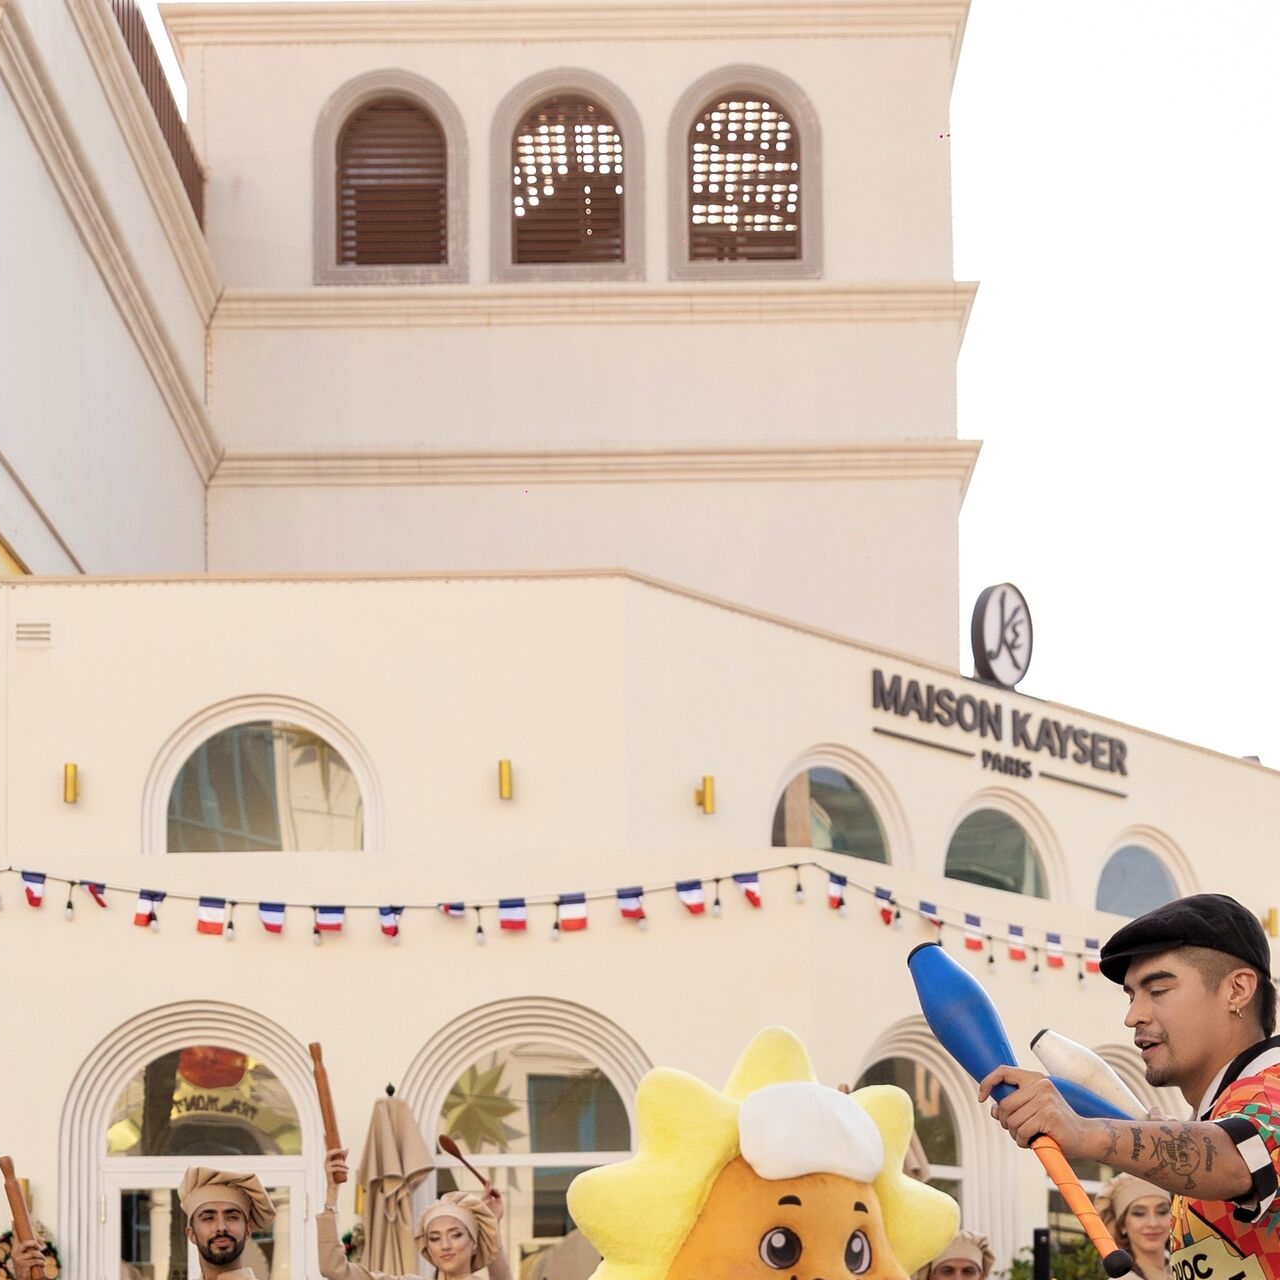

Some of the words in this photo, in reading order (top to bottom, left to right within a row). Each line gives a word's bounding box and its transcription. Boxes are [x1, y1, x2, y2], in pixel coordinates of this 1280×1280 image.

[871, 669, 1002, 741] MAISON
[1011, 709, 1128, 776] KAYSER
[982, 750, 1032, 778] PARIS
